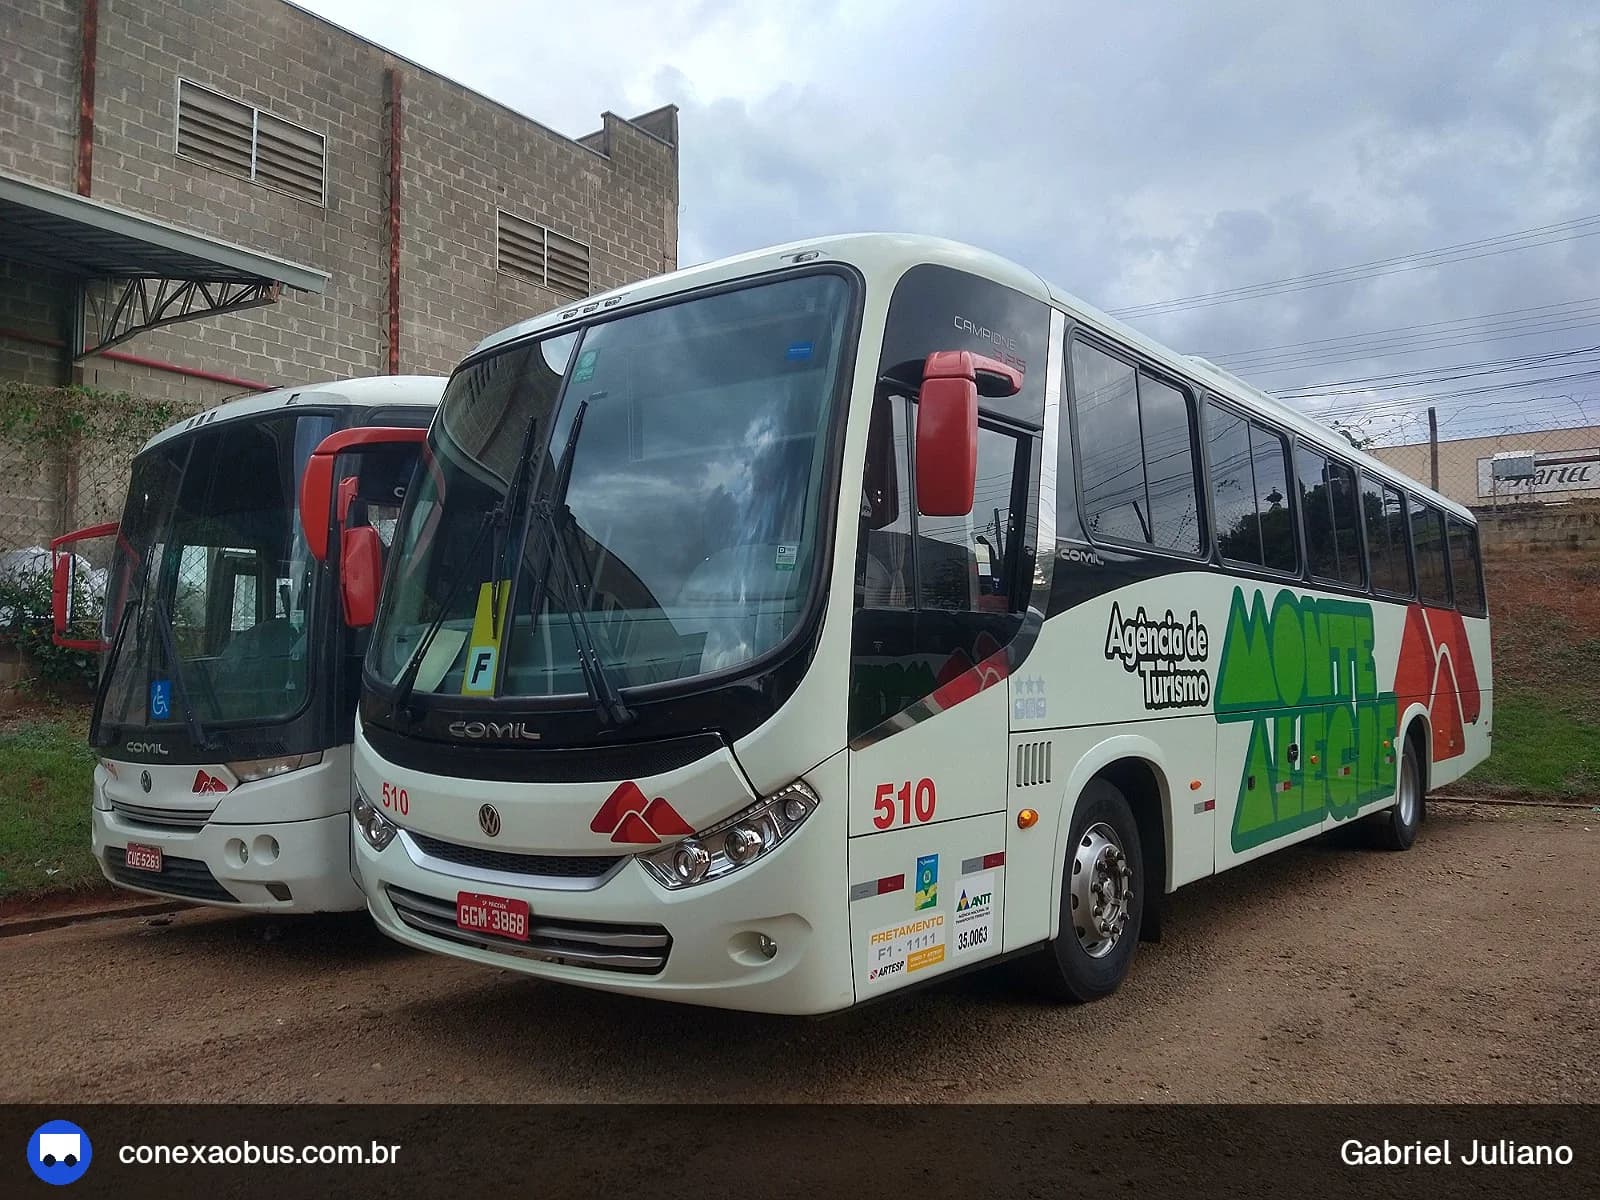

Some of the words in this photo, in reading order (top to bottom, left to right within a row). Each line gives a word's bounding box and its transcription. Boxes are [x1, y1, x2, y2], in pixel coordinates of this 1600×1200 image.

[954, 316, 1016, 350] CAMPIONE
[1060, 549, 1105, 566] COMIL
[1106, 601, 1185, 672] Agência
[1186, 608, 1209, 662] de
[1215, 588, 1377, 716] MONTE
[471, 653, 491, 684] F
[1139, 661, 1210, 709] Turismo
[449, 721, 541, 740] COMIL
[126, 741, 169, 755] COMIL
[382, 782, 409, 816] 510
[873, 777, 936, 830] 510
[970, 892, 992, 908] ANTT
[871, 915, 944, 945] FRETAMENTO
[958, 925, 988, 951] 35.0063
[877, 945, 892, 961] F1
[878, 961, 905, 978] ARTESP
